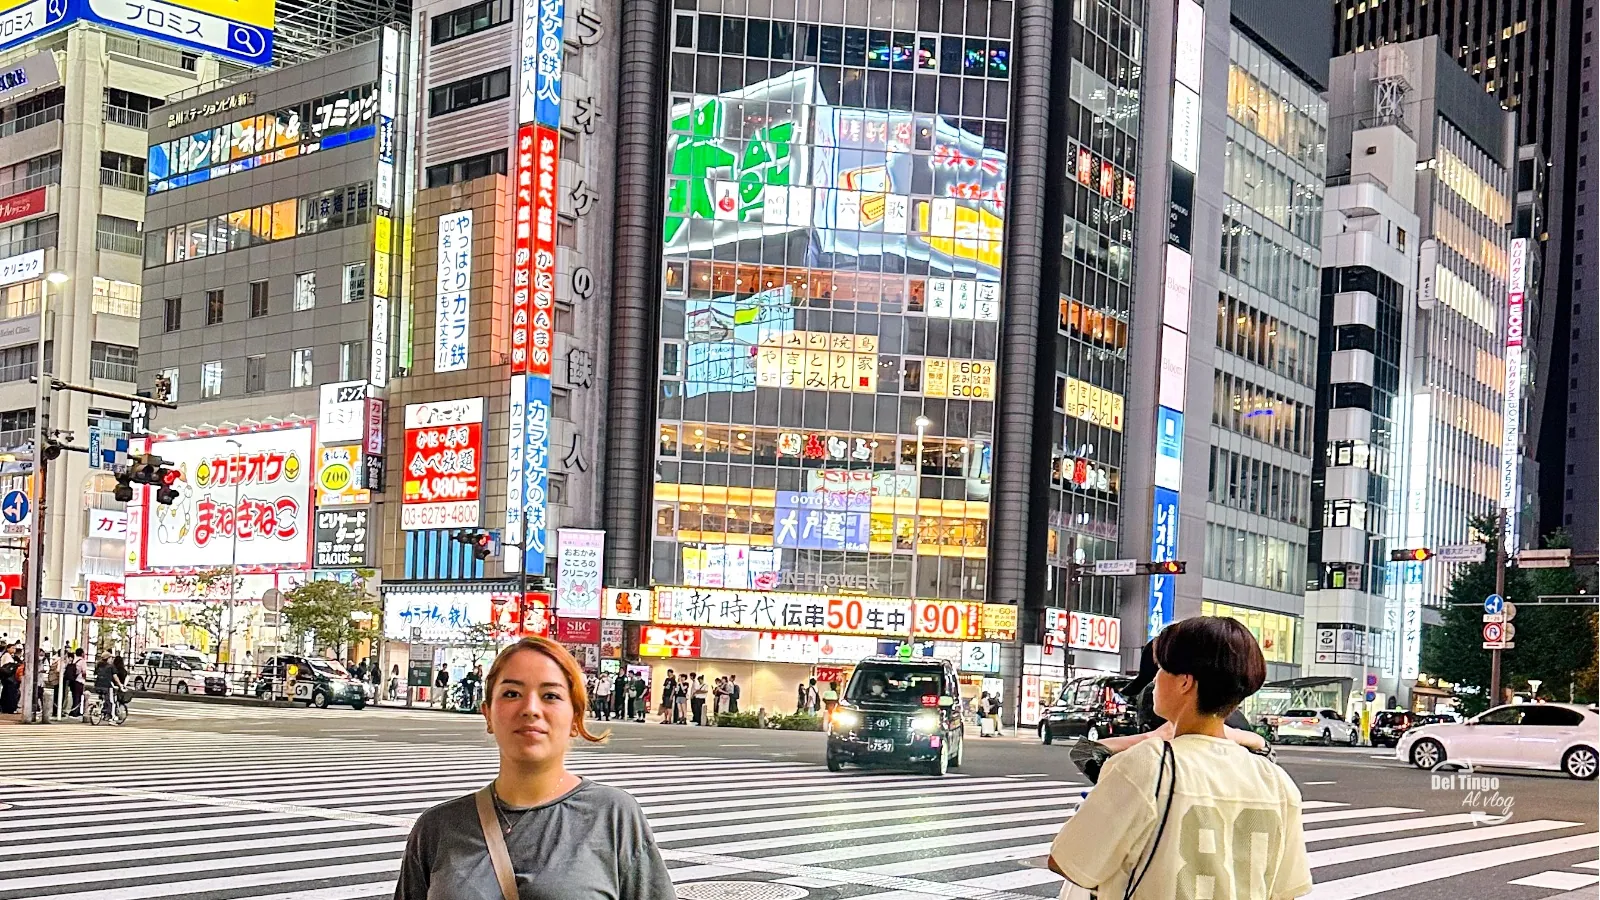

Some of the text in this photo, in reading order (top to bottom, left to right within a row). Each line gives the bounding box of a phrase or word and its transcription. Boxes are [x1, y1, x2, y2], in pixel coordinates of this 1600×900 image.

[125, 2, 204, 39] プロミス
[3, 258, 39, 277] クリニック
[449, 215, 471, 368] やっぱりカラ鉄
[1167, 276, 1188, 296] Bloom
[781, 368, 851, 390] すみれ
[960, 361, 991, 375] 60分
[338, 385, 367, 402] メンズ
[132, 400, 146, 418] 24
[371, 402, 381, 451] カラオケ
[1507, 401, 1517, 442] BOXING
[210, 452, 285, 486] カラオケ
[408, 448, 476, 476] 食べ放題
[506, 401, 524, 544] カラオケの鉄人
[525, 399, 548, 554] カラオケの鉄人
[193, 495, 298, 547] まねきねこ
[318, 511, 366, 529] ビリヤード
[404, 504, 477, 525] 03-6279-4800
[776, 510, 845, 545] 大戸屋
[563, 558, 597, 568] こころの
[564, 548, 597, 557] おおかみ
[561, 568, 598, 579] クリニック
[79, 604, 87, 613] 4
[400, 606, 472, 630] カラオケの鉄人
[686, 590, 778, 626] 新時代
[781, 602, 825, 629] 伝串
[827, 599, 863, 630] 50
[866, 608, 906, 633] 生中
[566, 621, 591, 632] SBC
[1088, 617, 1118, 650] 190
[296, 685, 308, 695] GO
[872, 743, 892, 752] 75-97
[1174, 804, 1283, 900] 80
